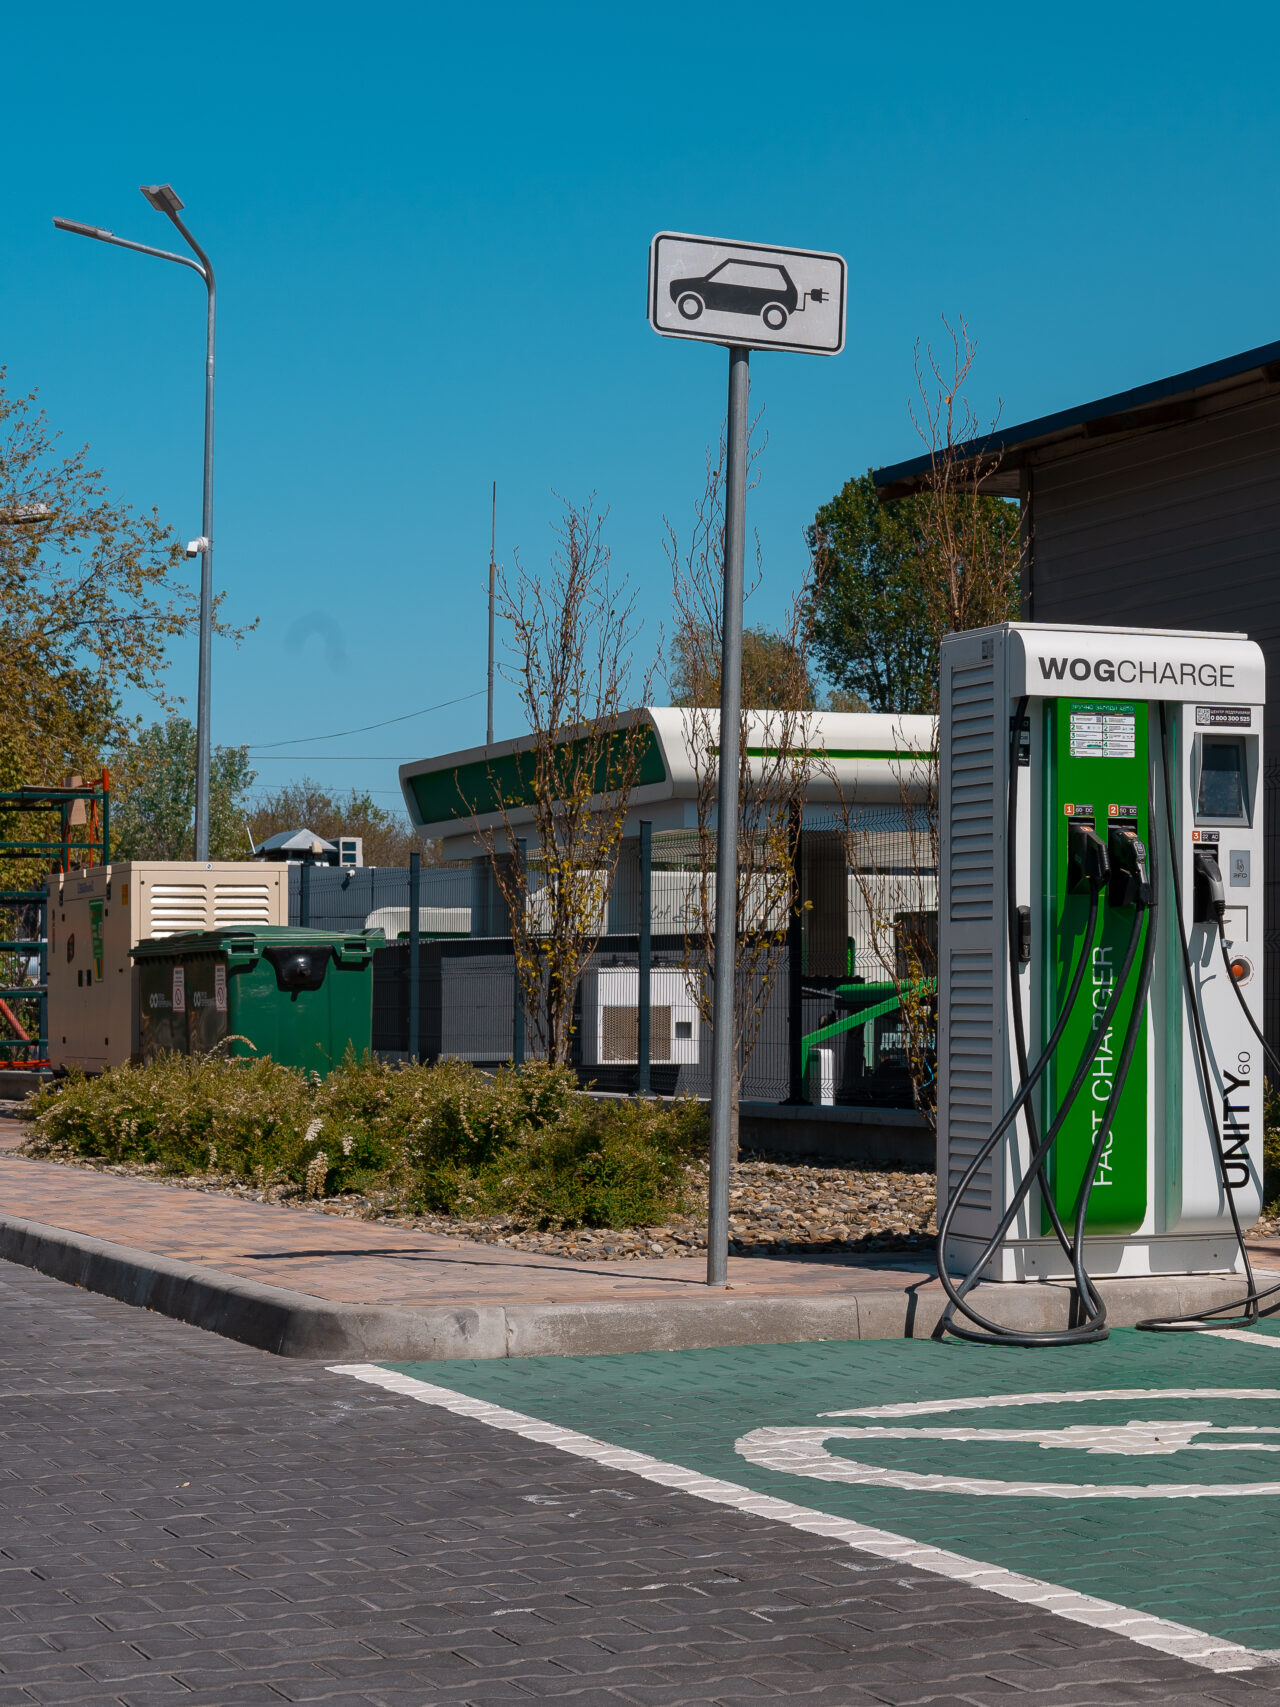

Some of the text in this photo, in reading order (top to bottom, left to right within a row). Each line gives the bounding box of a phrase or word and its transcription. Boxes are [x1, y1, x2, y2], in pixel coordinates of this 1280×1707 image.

[1038, 656, 1235, 688] WOGCHARGE
[1223, 1051, 1251, 1188] UNITY 60
